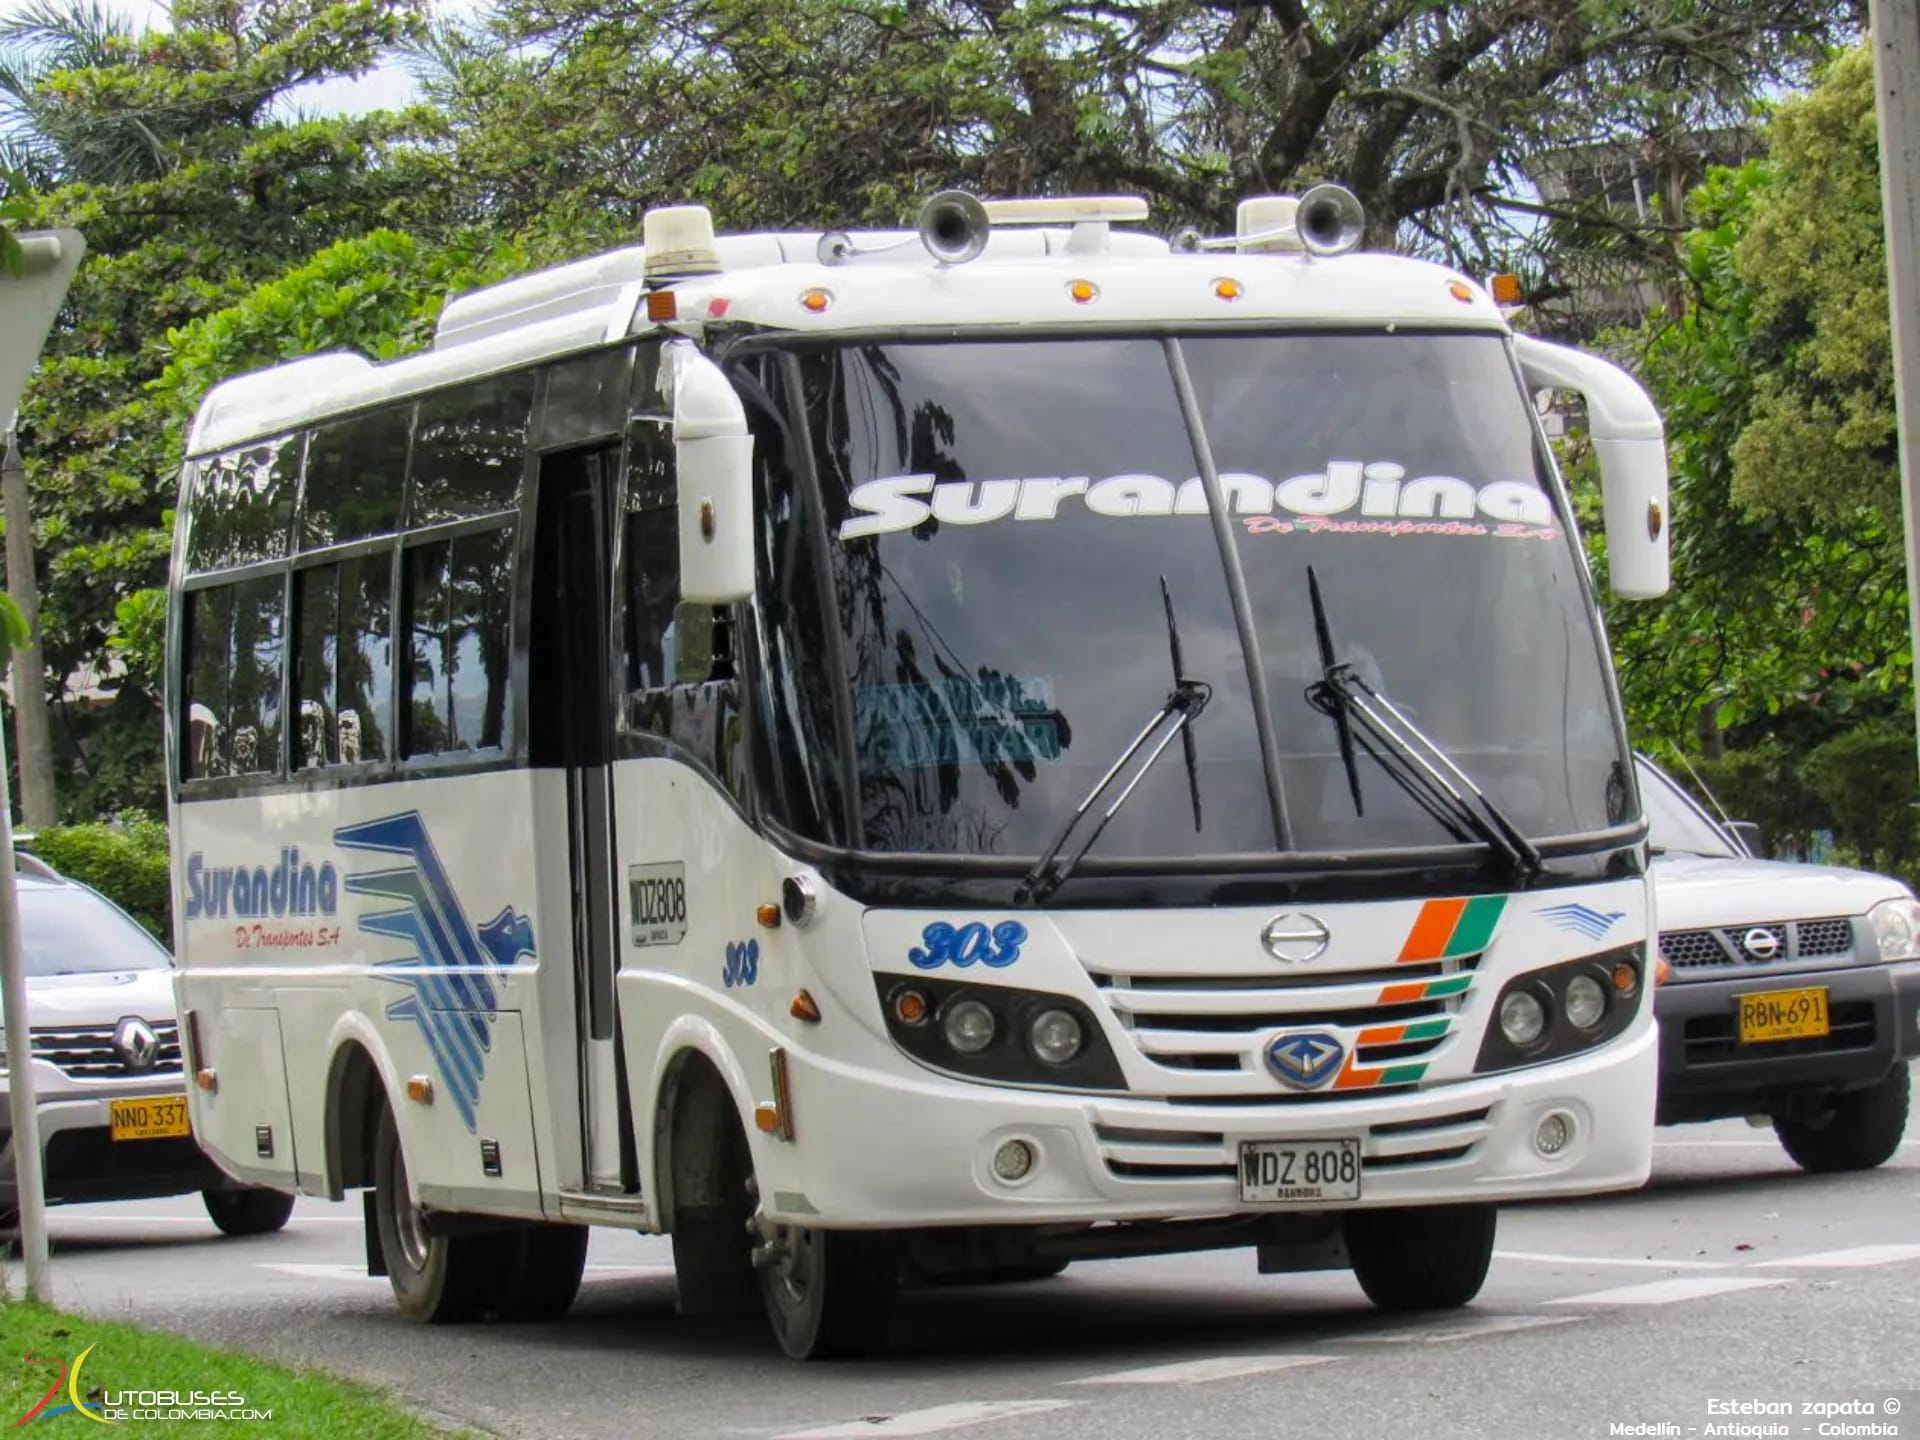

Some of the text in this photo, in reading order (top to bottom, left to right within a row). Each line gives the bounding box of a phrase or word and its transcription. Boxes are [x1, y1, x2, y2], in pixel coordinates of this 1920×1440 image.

[839, 461, 1552, 540] Surandina
[185, 845, 337, 920] Surandina
[630, 877, 686, 926] WDZ808
[252, 924, 313, 950] Transportes
[908, 920, 1028, 969] 303
[1305, 1149, 1356, 1184] 808
